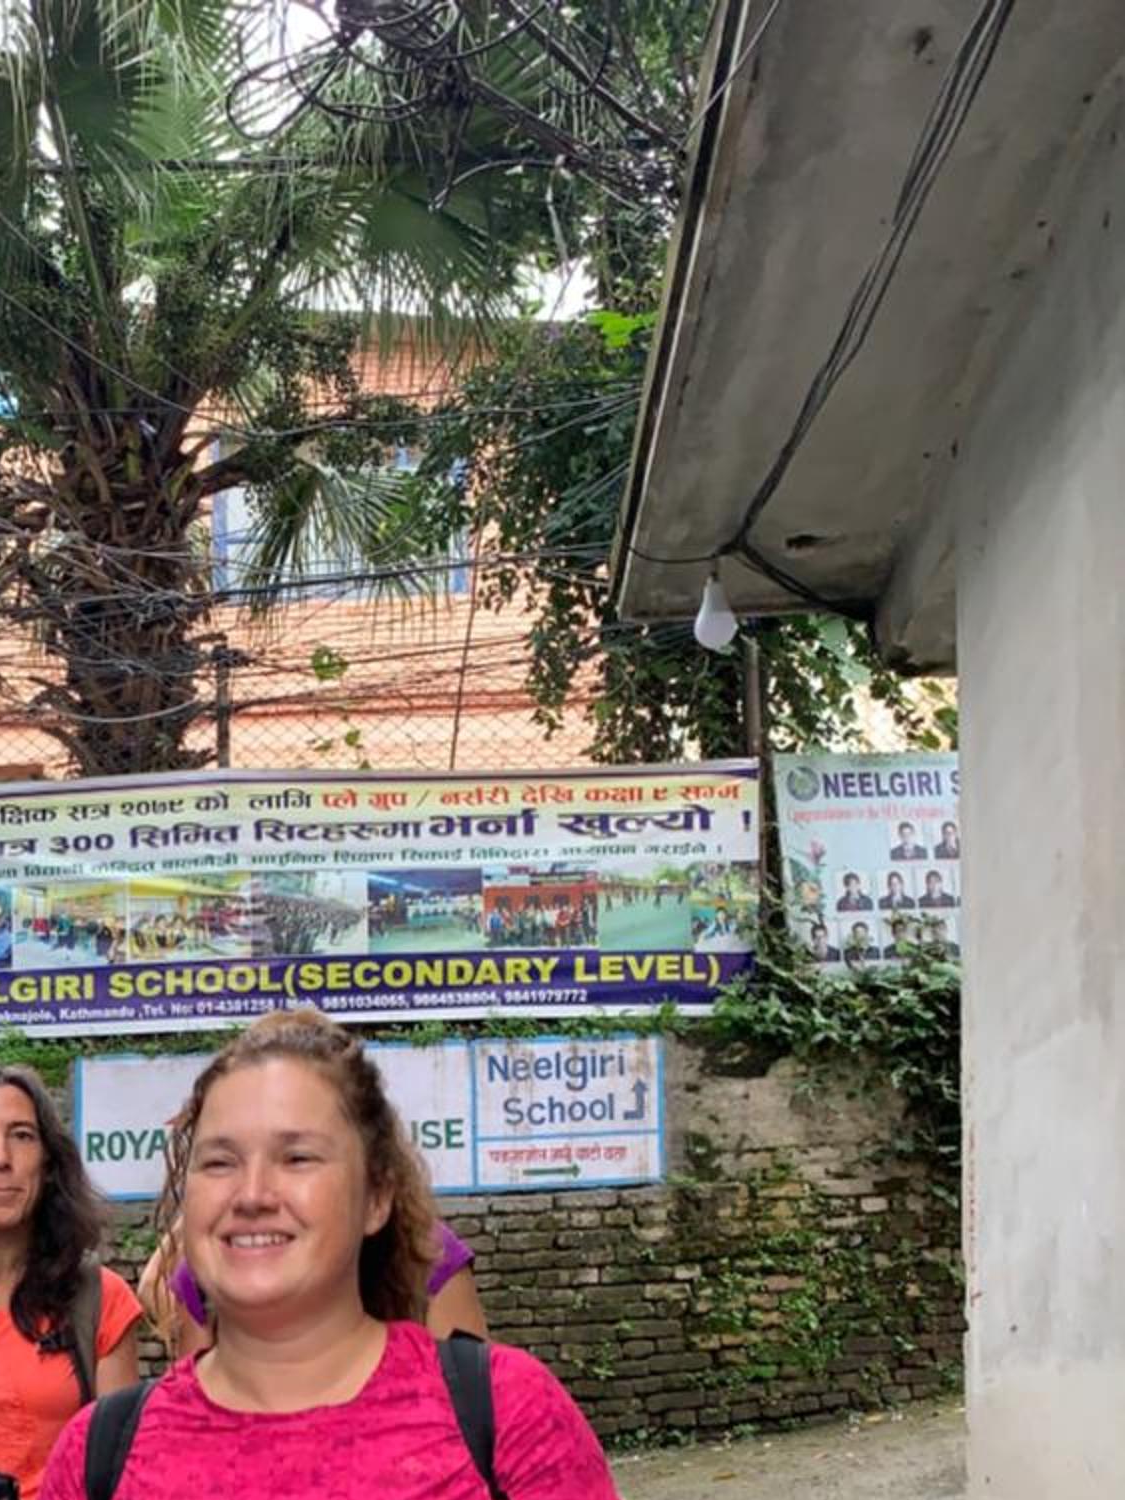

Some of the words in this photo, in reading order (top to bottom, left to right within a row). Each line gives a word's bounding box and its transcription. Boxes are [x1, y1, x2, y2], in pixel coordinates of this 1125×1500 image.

[821, 770, 942, 798] NEELGIRI
[68, 801, 111, 822] सत्र
[195, 790, 230, 812] को
[248, 787, 312, 811] लागि
[322, 787, 358, 811] प्ले
[367, 791, 408, 812] ग्रुप
[521, 783, 573, 806] देखि
[584, 785, 643, 805] कक्षा
[677, 783, 742, 802] सम्म
[129, 821, 242, 849] सिमित
[428, 807, 539, 838] भर्ना
[557, 804, 715, 840] खुल्यो
[575, 954, 721, 986] LEVEL)
[59, 1004, 135, 1021] Kathmandu
[487, 1047, 625, 1092] Neelgiri
[502, 1092, 615, 1126] School
